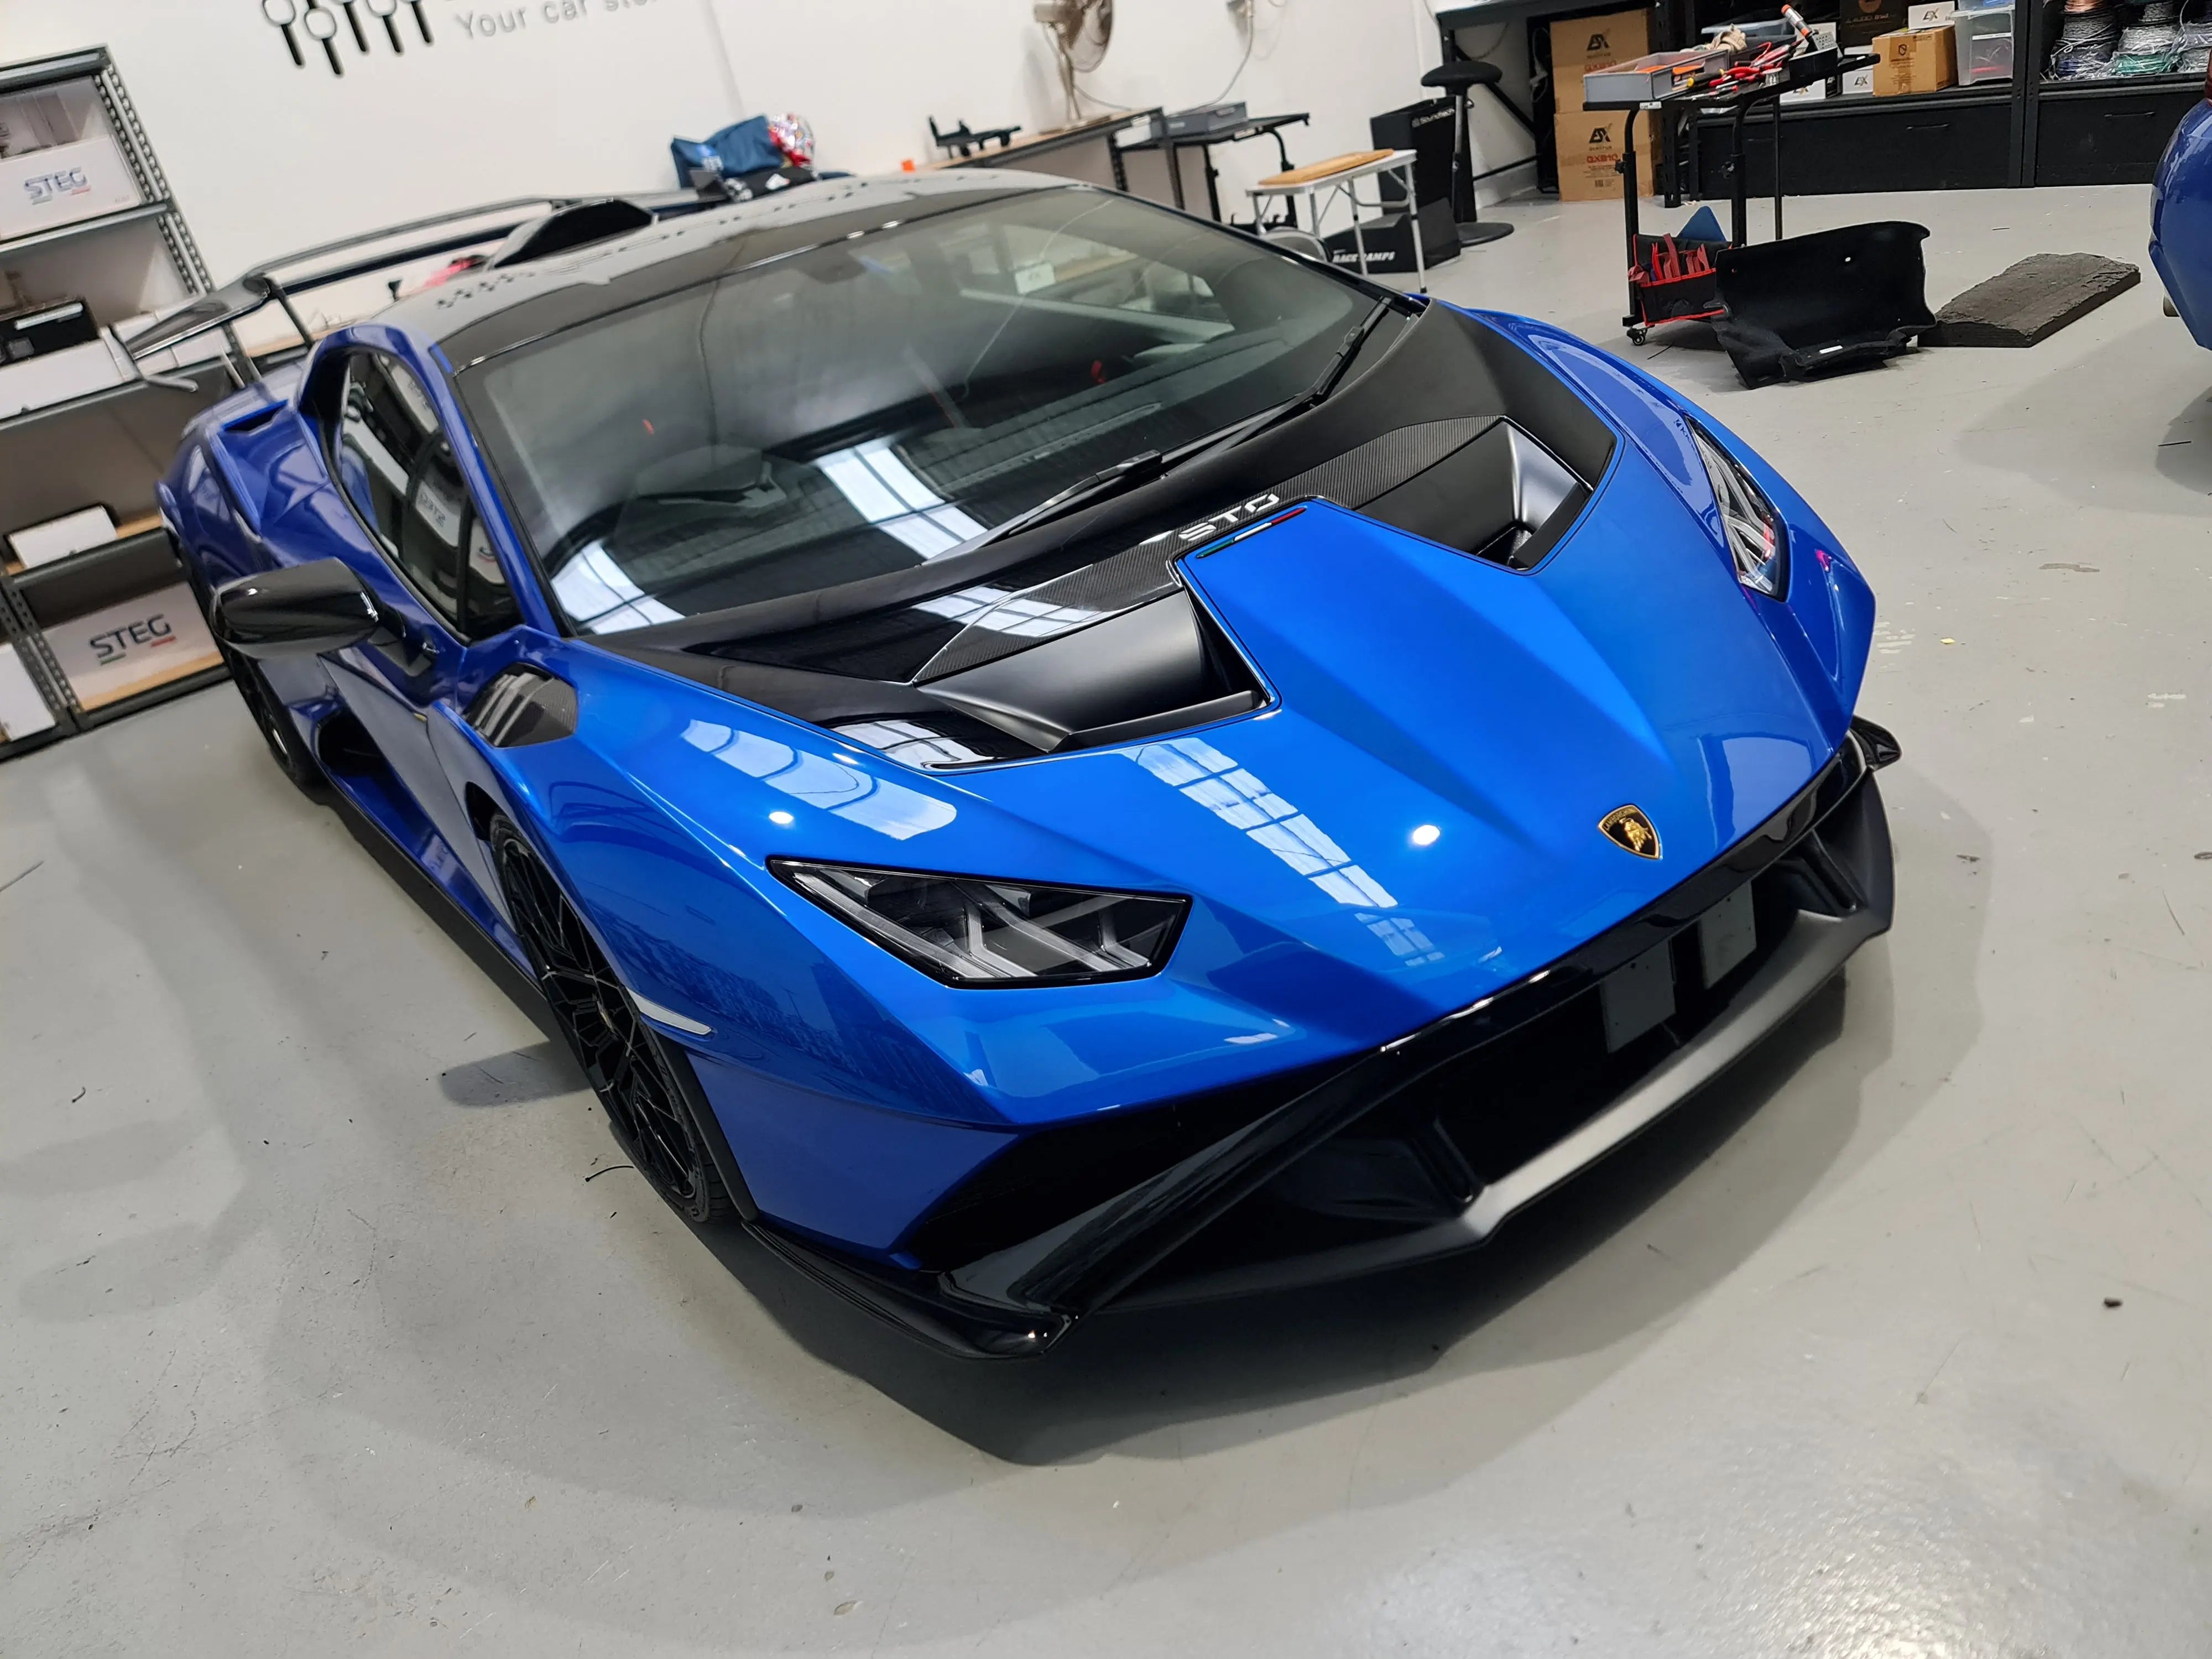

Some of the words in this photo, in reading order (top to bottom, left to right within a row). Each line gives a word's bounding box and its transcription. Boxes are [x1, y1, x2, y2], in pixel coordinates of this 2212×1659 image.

[454, 8, 526, 39] Your
[542, 0, 588, 23] car
[24, 166, 88, 199] STEG
[1178, 493, 1280, 542] STO
[88, 613, 172, 659] STEG
